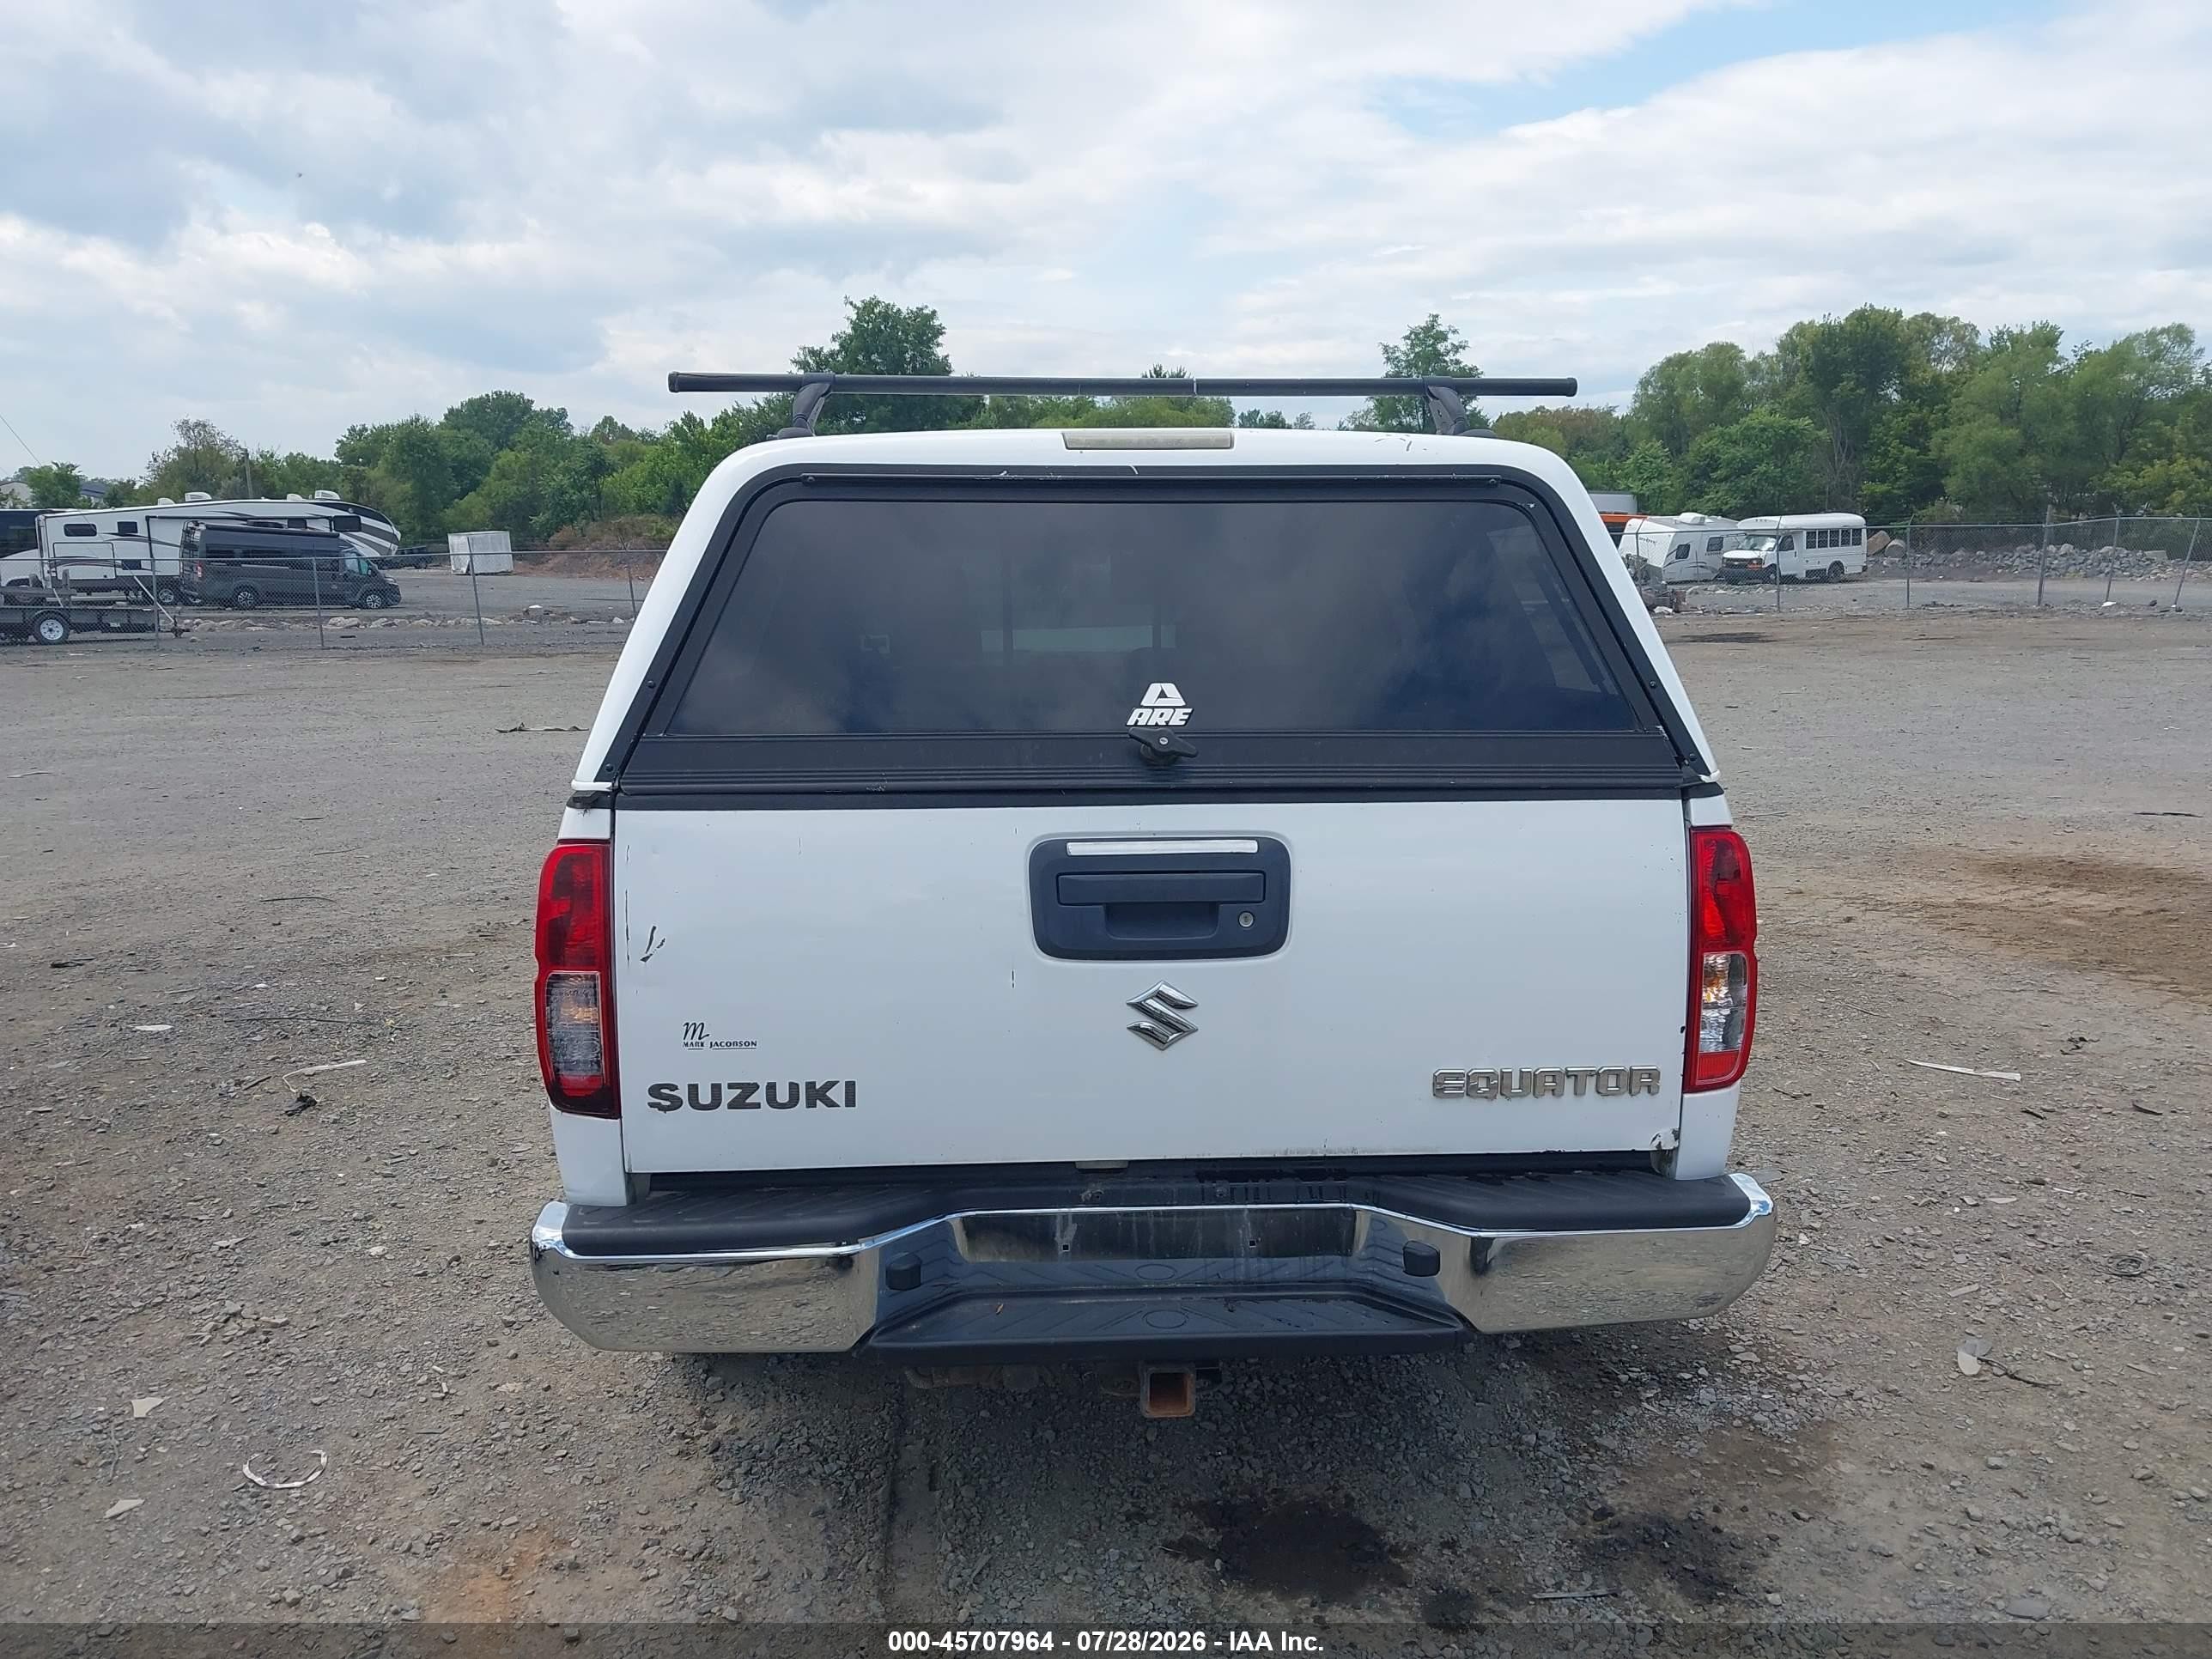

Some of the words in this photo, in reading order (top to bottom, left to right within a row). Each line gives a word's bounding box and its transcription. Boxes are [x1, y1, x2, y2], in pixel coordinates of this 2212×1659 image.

[1127, 708, 1194, 726] ARE
[709, 1040, 757, 1048] JACOBSON
[1433, 1065, 1661, 1099] EQUATOR
[647, 1080, 857, 1114] SUZUKI
